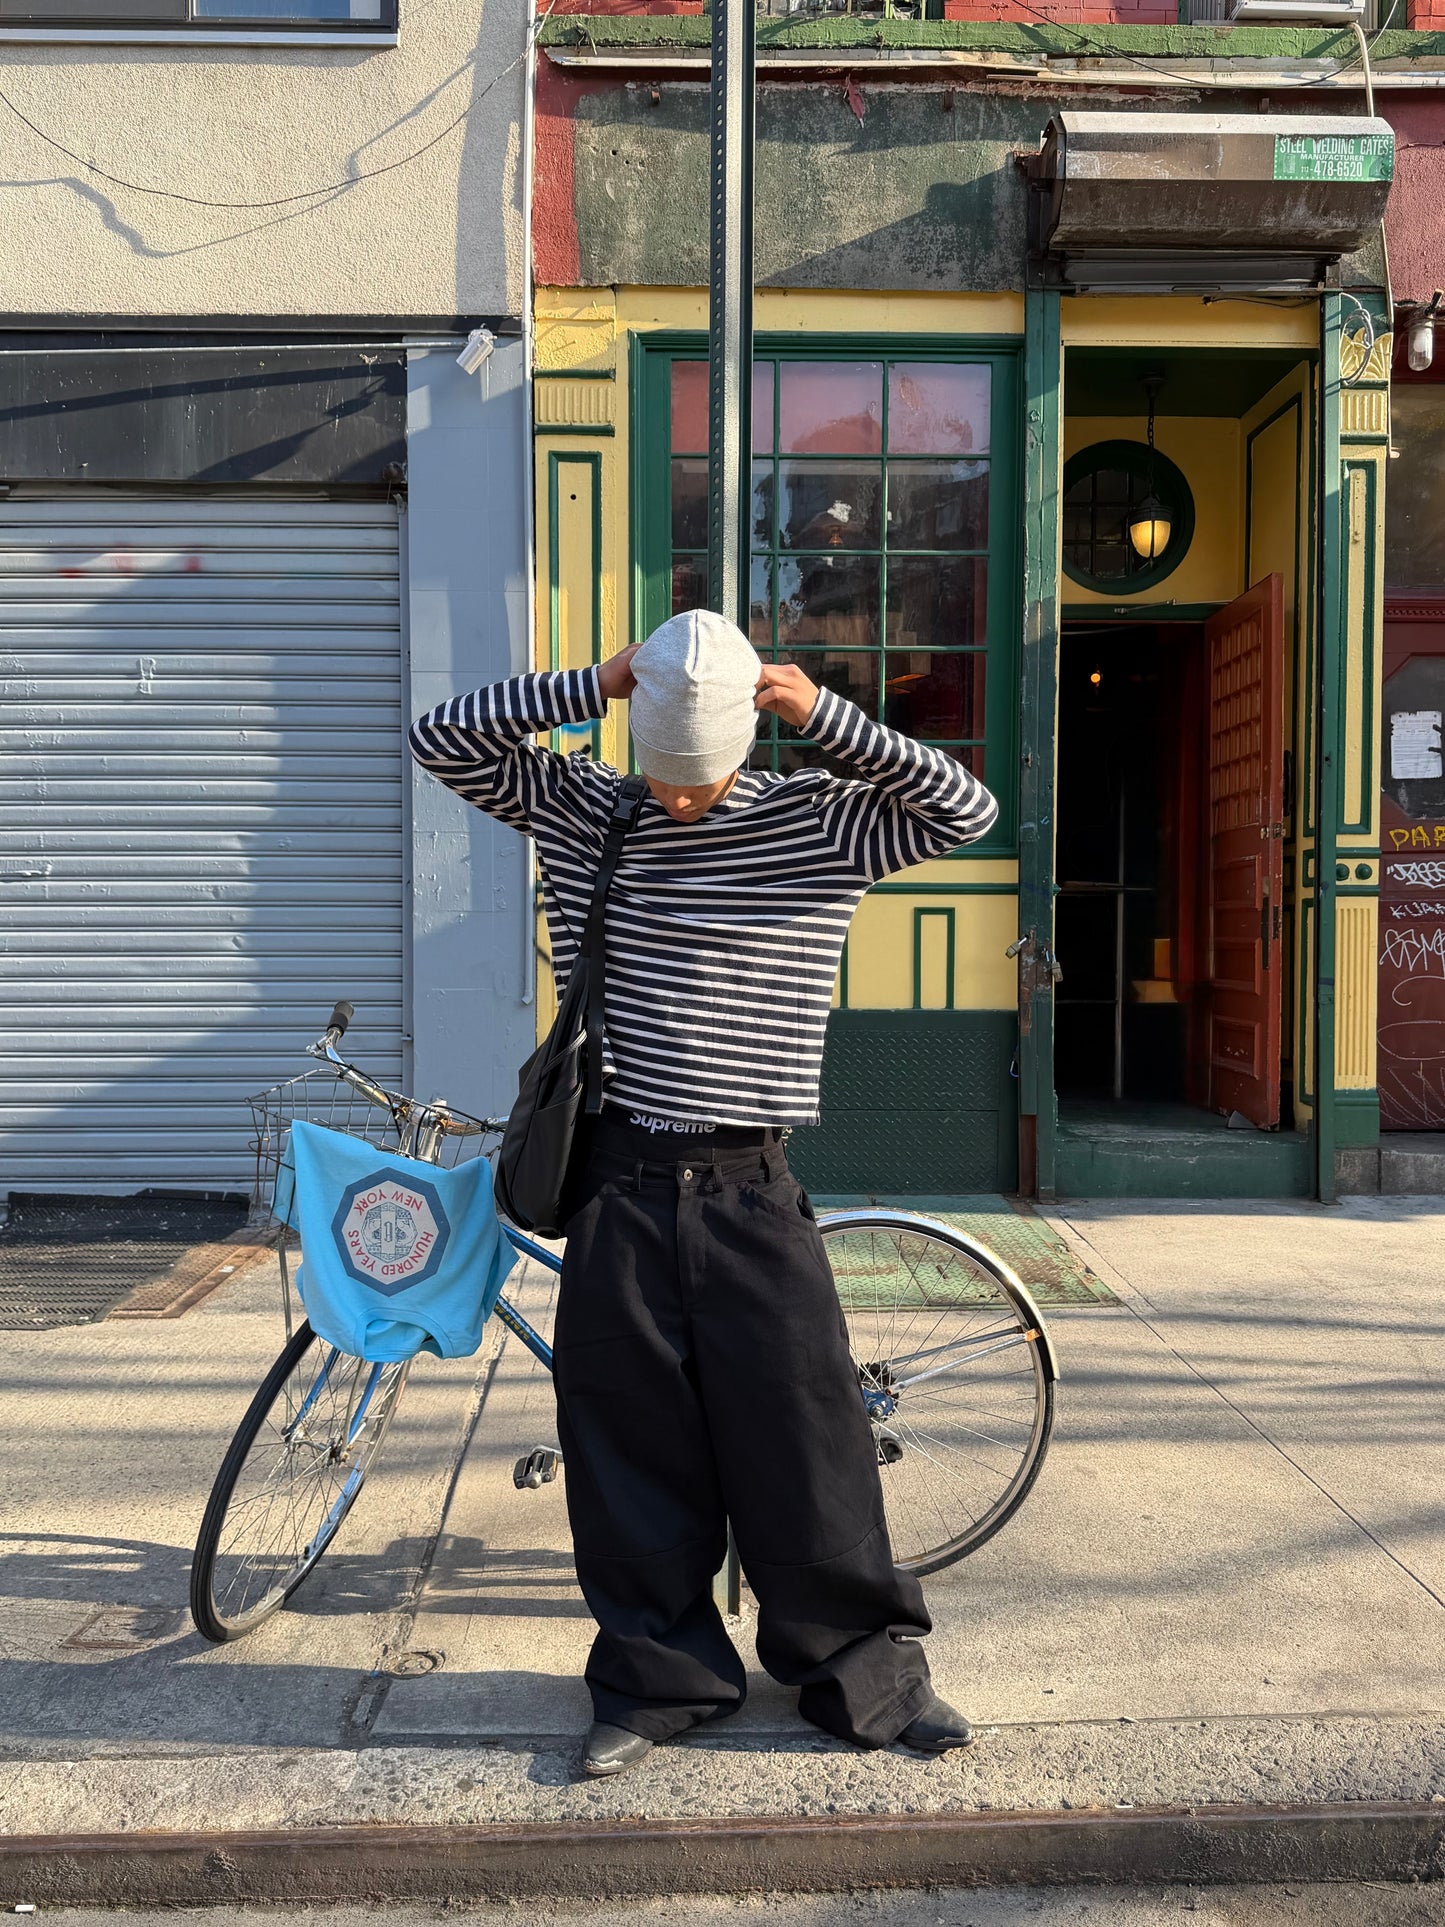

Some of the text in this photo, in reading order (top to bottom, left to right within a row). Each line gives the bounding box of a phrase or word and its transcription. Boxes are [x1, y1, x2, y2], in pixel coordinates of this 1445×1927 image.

[1280, 137, 1389, 156] STEEL WELDING GATES
[1300, 153, 1365, 162] MANUFACTURER
[629, 1111, 717, 1134] Supreme
[353, 1188, 423, 1216] NEW YORK
[348, 1229, 434, 1276] HUNDRED YEARS
